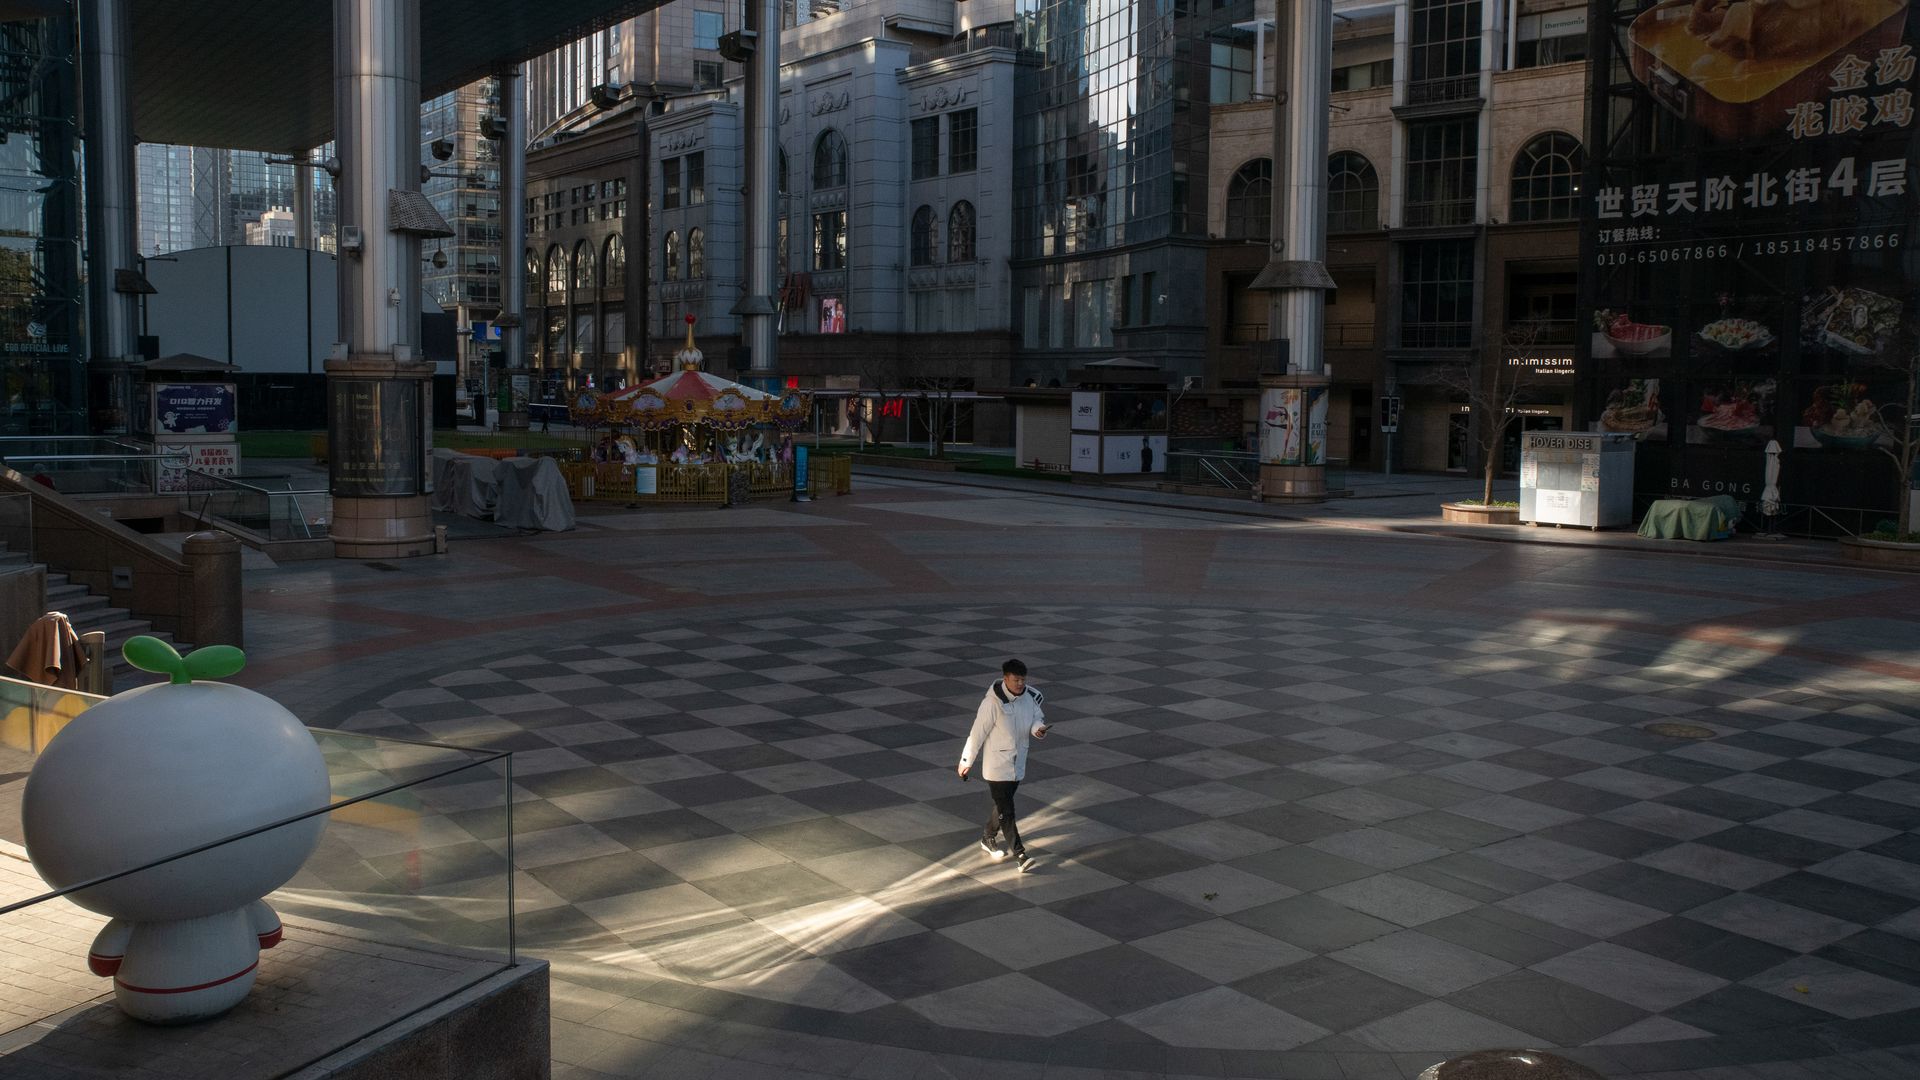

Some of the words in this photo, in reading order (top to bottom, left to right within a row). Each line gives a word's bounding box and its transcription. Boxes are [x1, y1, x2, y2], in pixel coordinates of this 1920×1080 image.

[1829, 45, 1917, 92] 金汤
[1785, 88, 1914, 139] 花胶鸡
[1595, 157, 1907, 219] 世贸天阶北街4层
[1597, 244, 1728, 266] 010-65067866
[1754, 233, 1900, 256] 18518457866
[20, 343, 52, 353] OFFICIAL
[53, 343, 69, 353] LIVE
[1529, 437, 1563, 449] HOVER
[1670, 477, 1690, 489] BA
[1702, 480, 1751, 494] GONG
